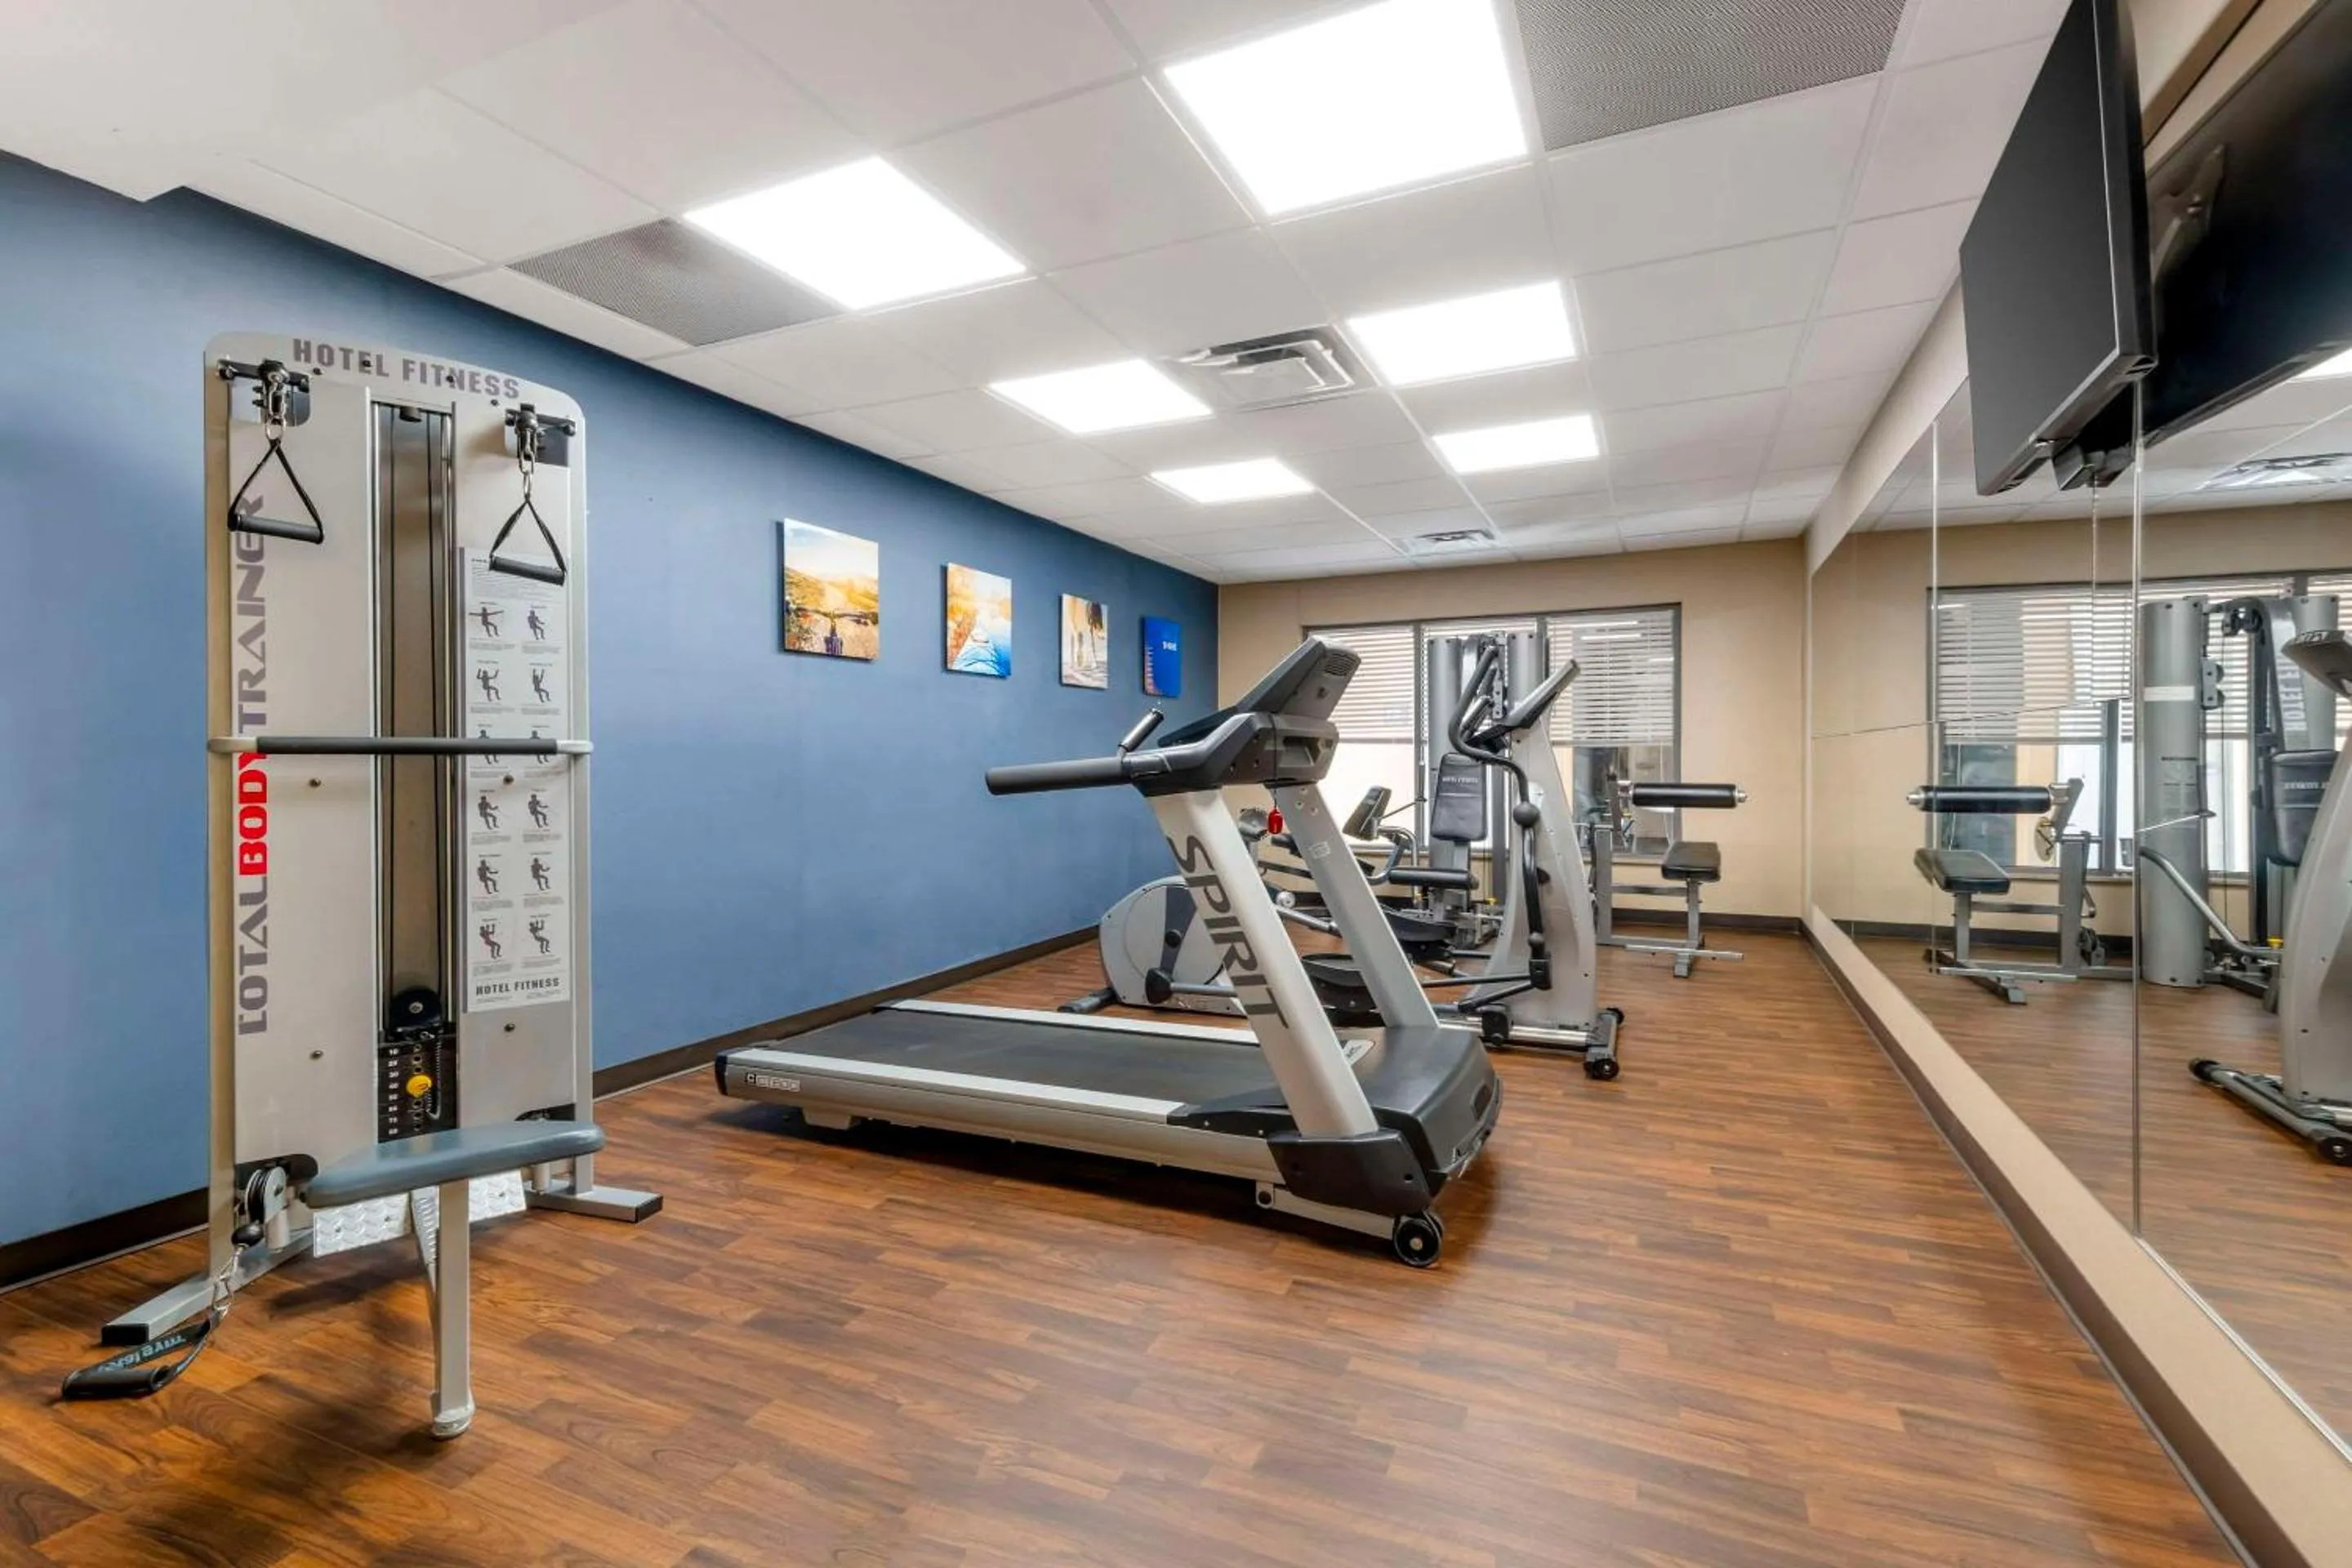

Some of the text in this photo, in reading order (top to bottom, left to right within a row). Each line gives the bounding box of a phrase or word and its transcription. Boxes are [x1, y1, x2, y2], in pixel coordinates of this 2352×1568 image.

[292, 338, 519, 399] HOTEL FITNESS
[1166, 834, 1289, 1029] SPIRIT
[475, 978, 560, 996] HOTEL FITNESS
